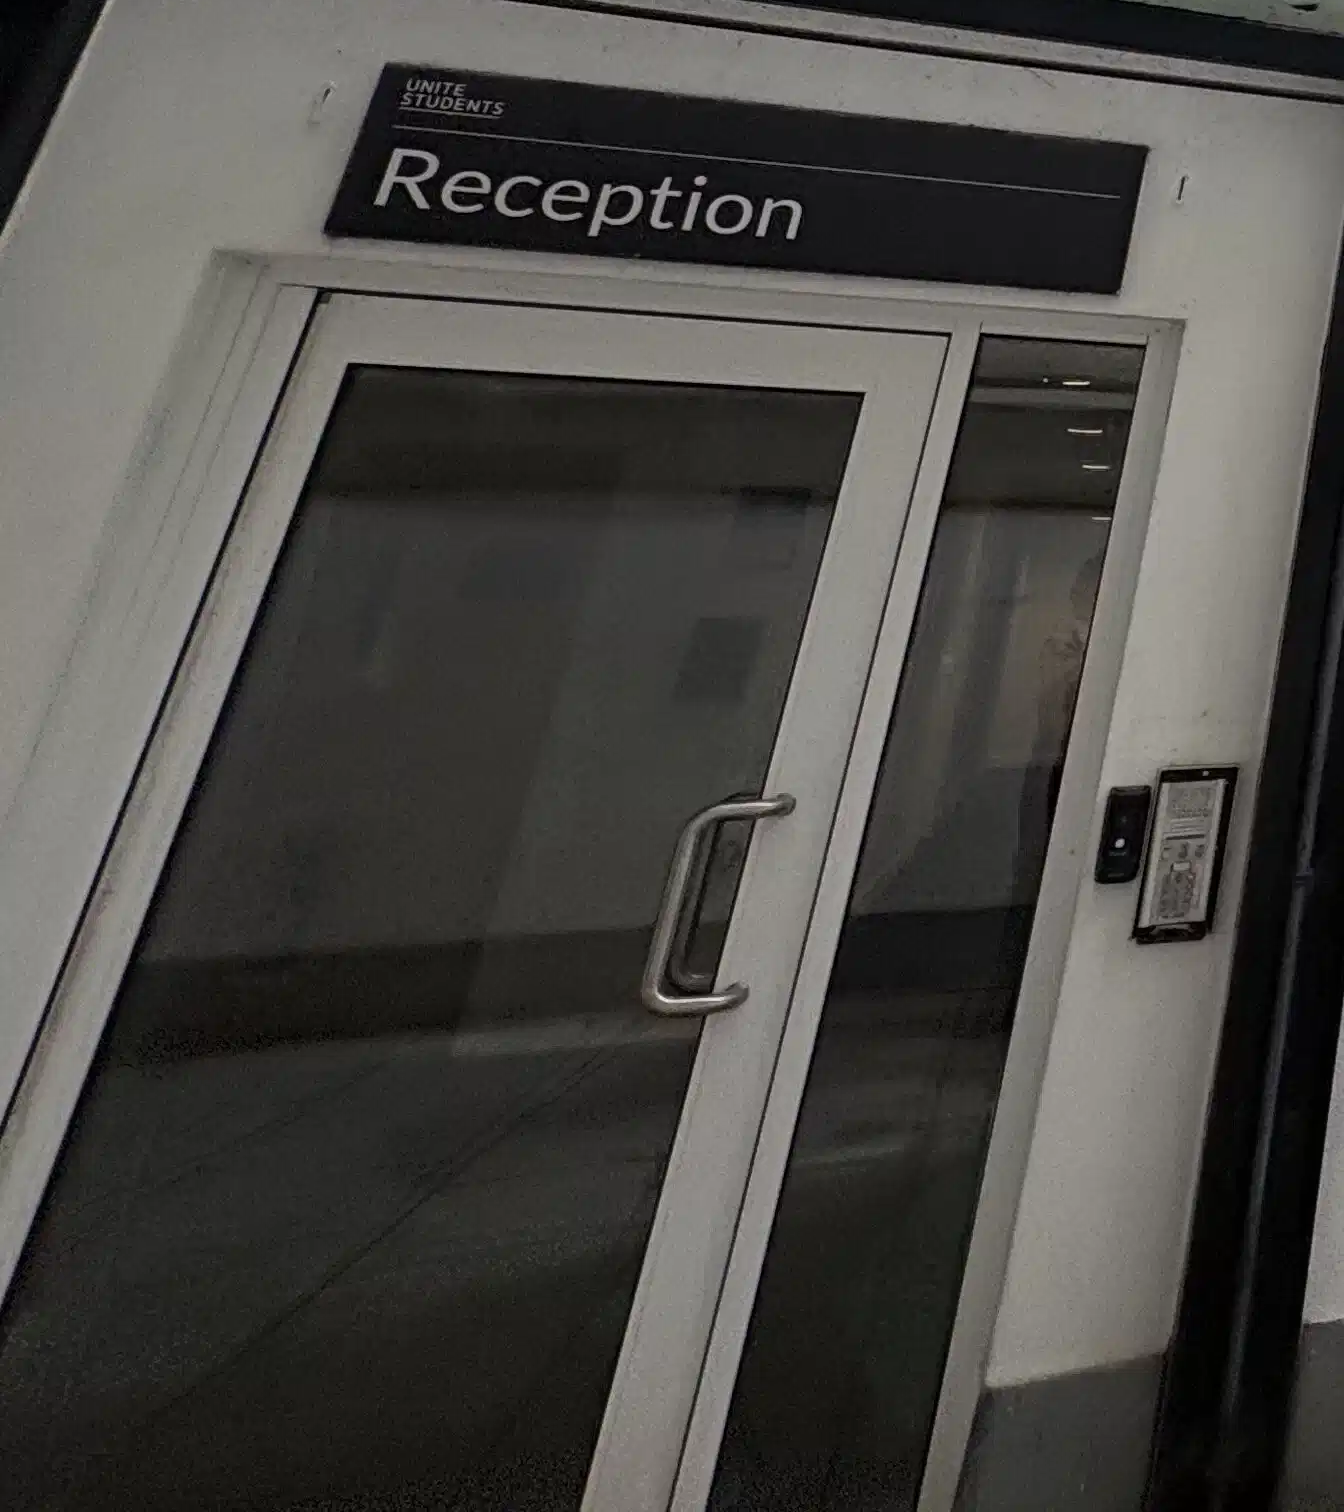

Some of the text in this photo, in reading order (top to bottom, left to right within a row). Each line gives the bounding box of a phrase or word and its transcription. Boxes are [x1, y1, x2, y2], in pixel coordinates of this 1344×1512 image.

[406, 78, 467, 97] UNITE
[400, 92, 505, 115] STUDENTS
[373, 147, 803, 240] Reception
